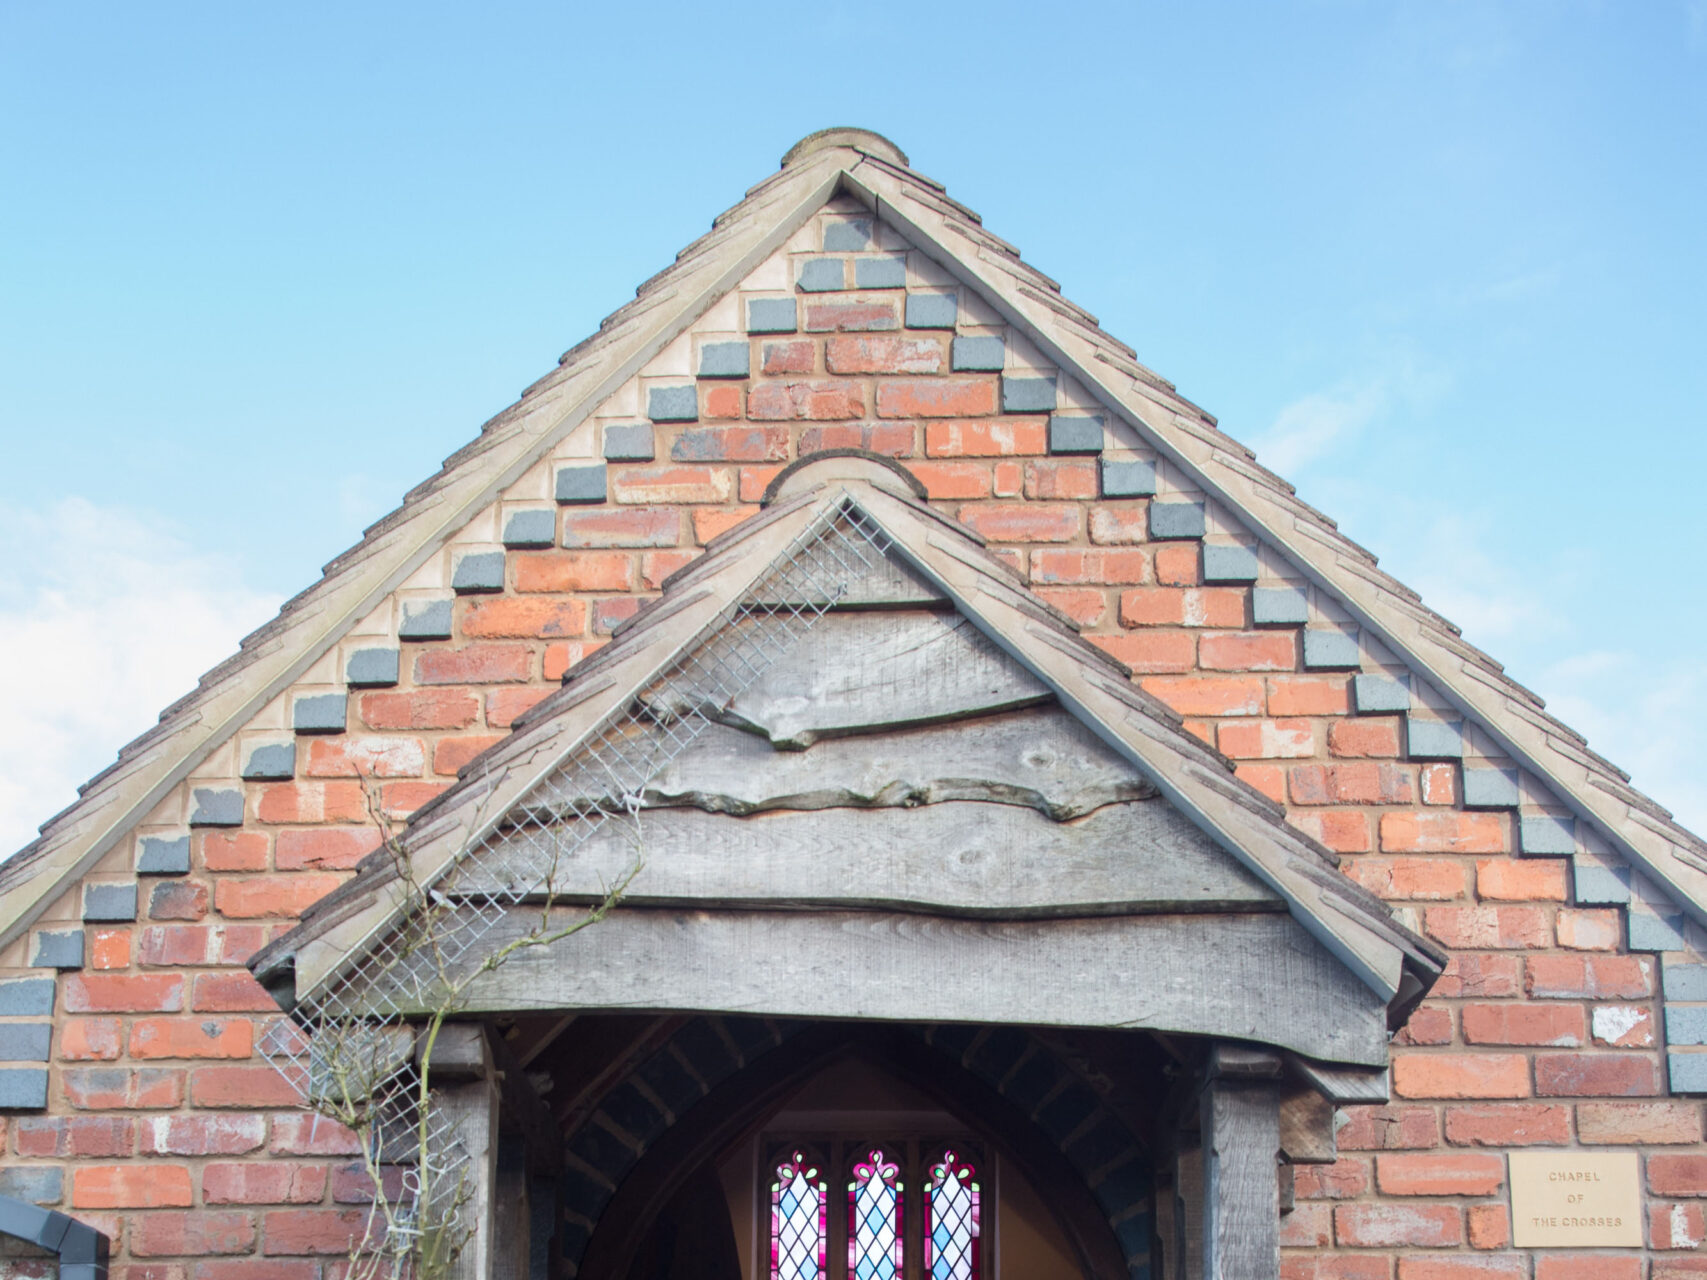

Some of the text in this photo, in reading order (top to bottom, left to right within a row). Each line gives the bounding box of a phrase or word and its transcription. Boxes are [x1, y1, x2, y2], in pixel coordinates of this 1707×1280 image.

[1548, 1171, 1601, 1182] CHAPEL
[1567, 1194, 1584, 1204] OF
[1532, 1217, 1622, 1227] THE CROSSES
